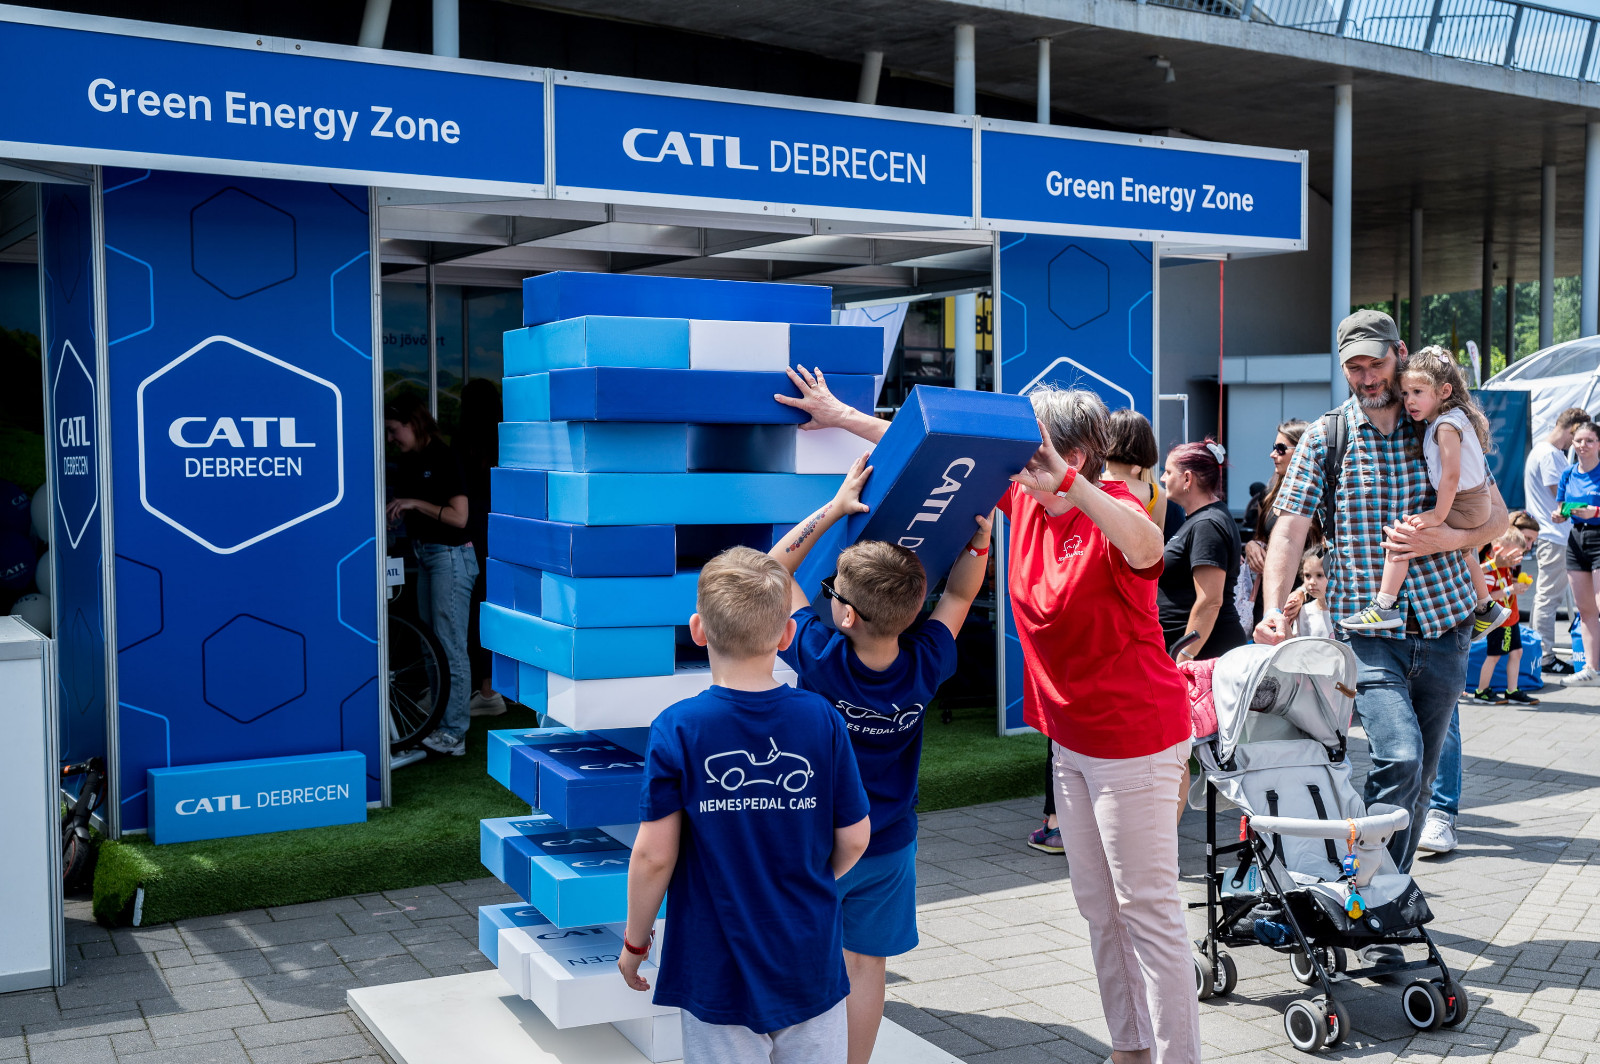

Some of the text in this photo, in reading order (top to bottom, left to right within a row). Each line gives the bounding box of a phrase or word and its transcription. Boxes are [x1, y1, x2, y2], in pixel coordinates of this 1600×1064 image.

[87, 77, 461, 144] Green Energy Zone
[622, 127, 926, 185] CATL DEBRECEN
[1046, 170, 1254, 213] Green Energy Zone
[400, 332, 446, 348] jövőrt
[59, 415, 91, 448] CATL
[168, 416, 316, 448] CATL
[63, 455, 89, 476] DEBRECEN
[185, 456, 303, 478] DEBRECEN
[906, 457, 976, 531] CATL
[386, 567, 401, 577] ATL
[862, 726, 896, 736] PEDAL
[175, 783, 350, 816] CATL DEBRECEN
[699, 796, 817, 813] NEMES PEDAL CARS
[536, 926, 605, 940] CAT
